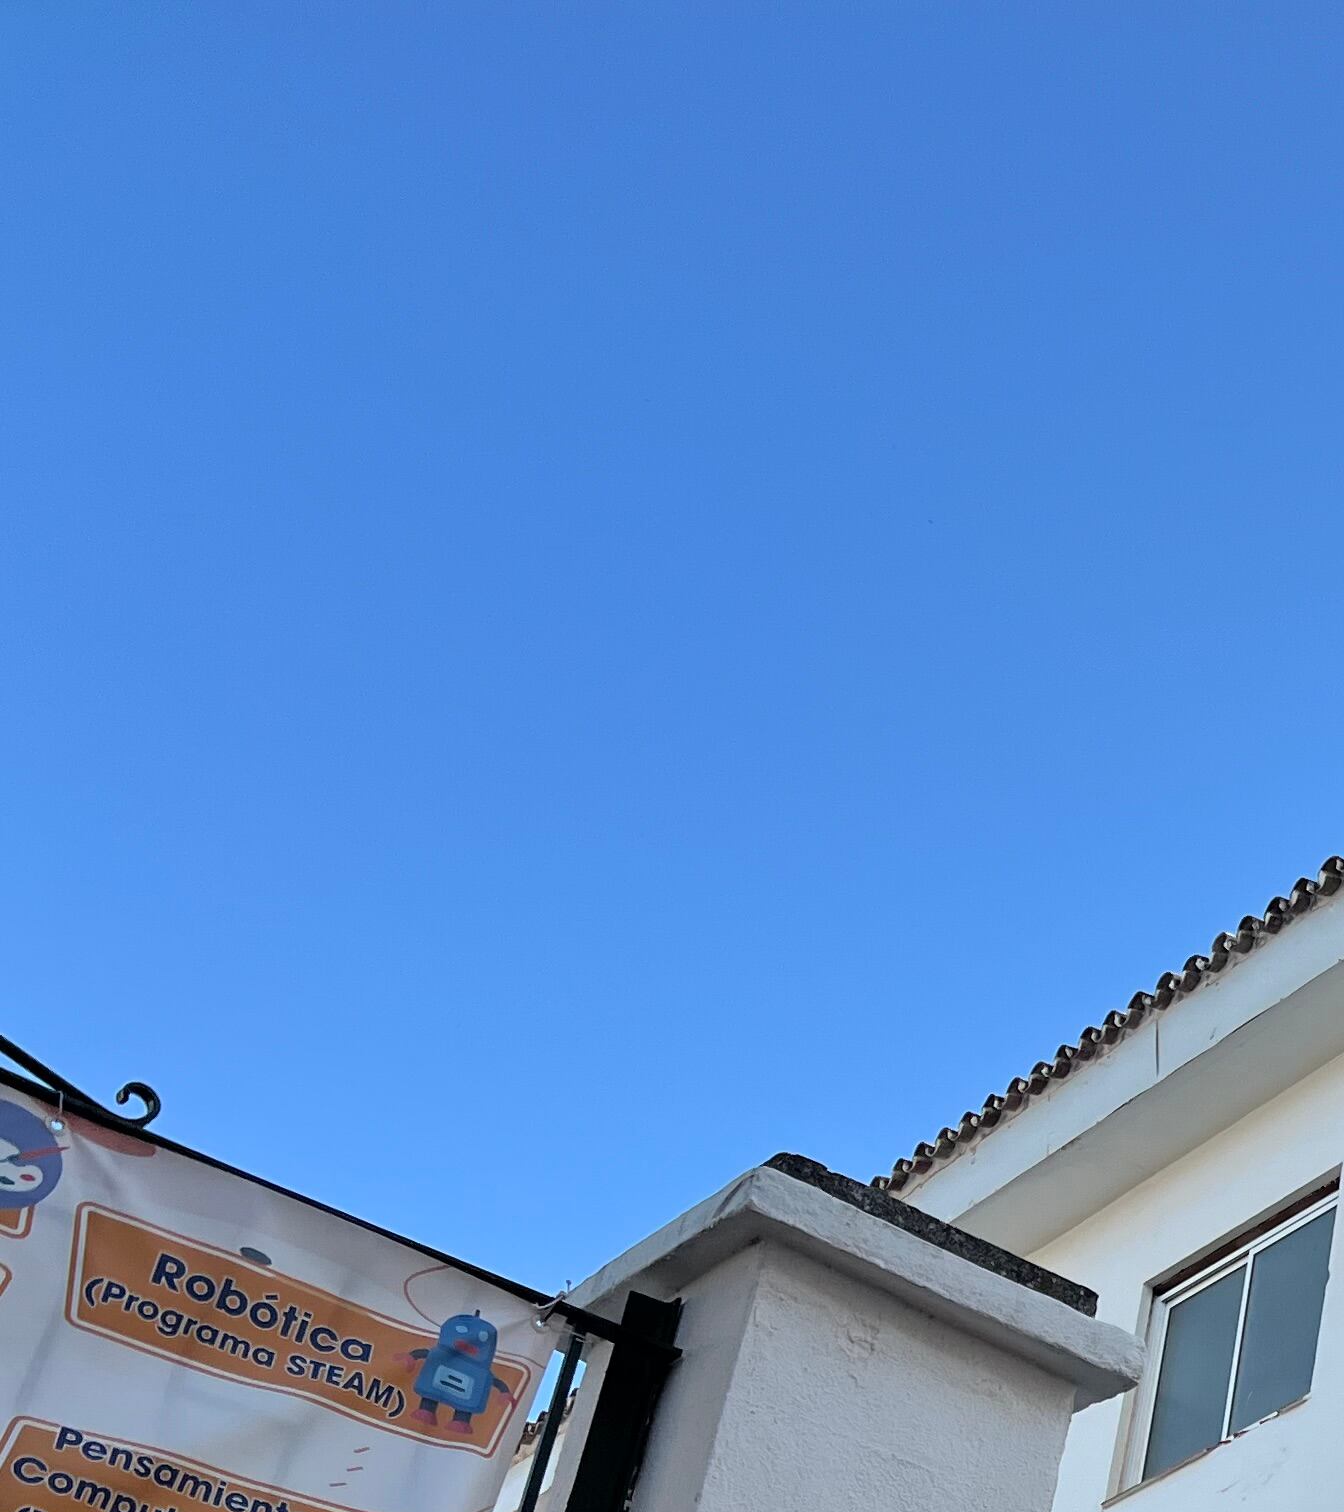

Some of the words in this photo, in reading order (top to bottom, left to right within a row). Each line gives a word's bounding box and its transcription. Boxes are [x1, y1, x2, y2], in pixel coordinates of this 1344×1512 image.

[84, 1278, 275, 1368] (Programa
[286, 1354, 407, 1418] STEAM)
[151, 1252, 373, 1364] Robótica
